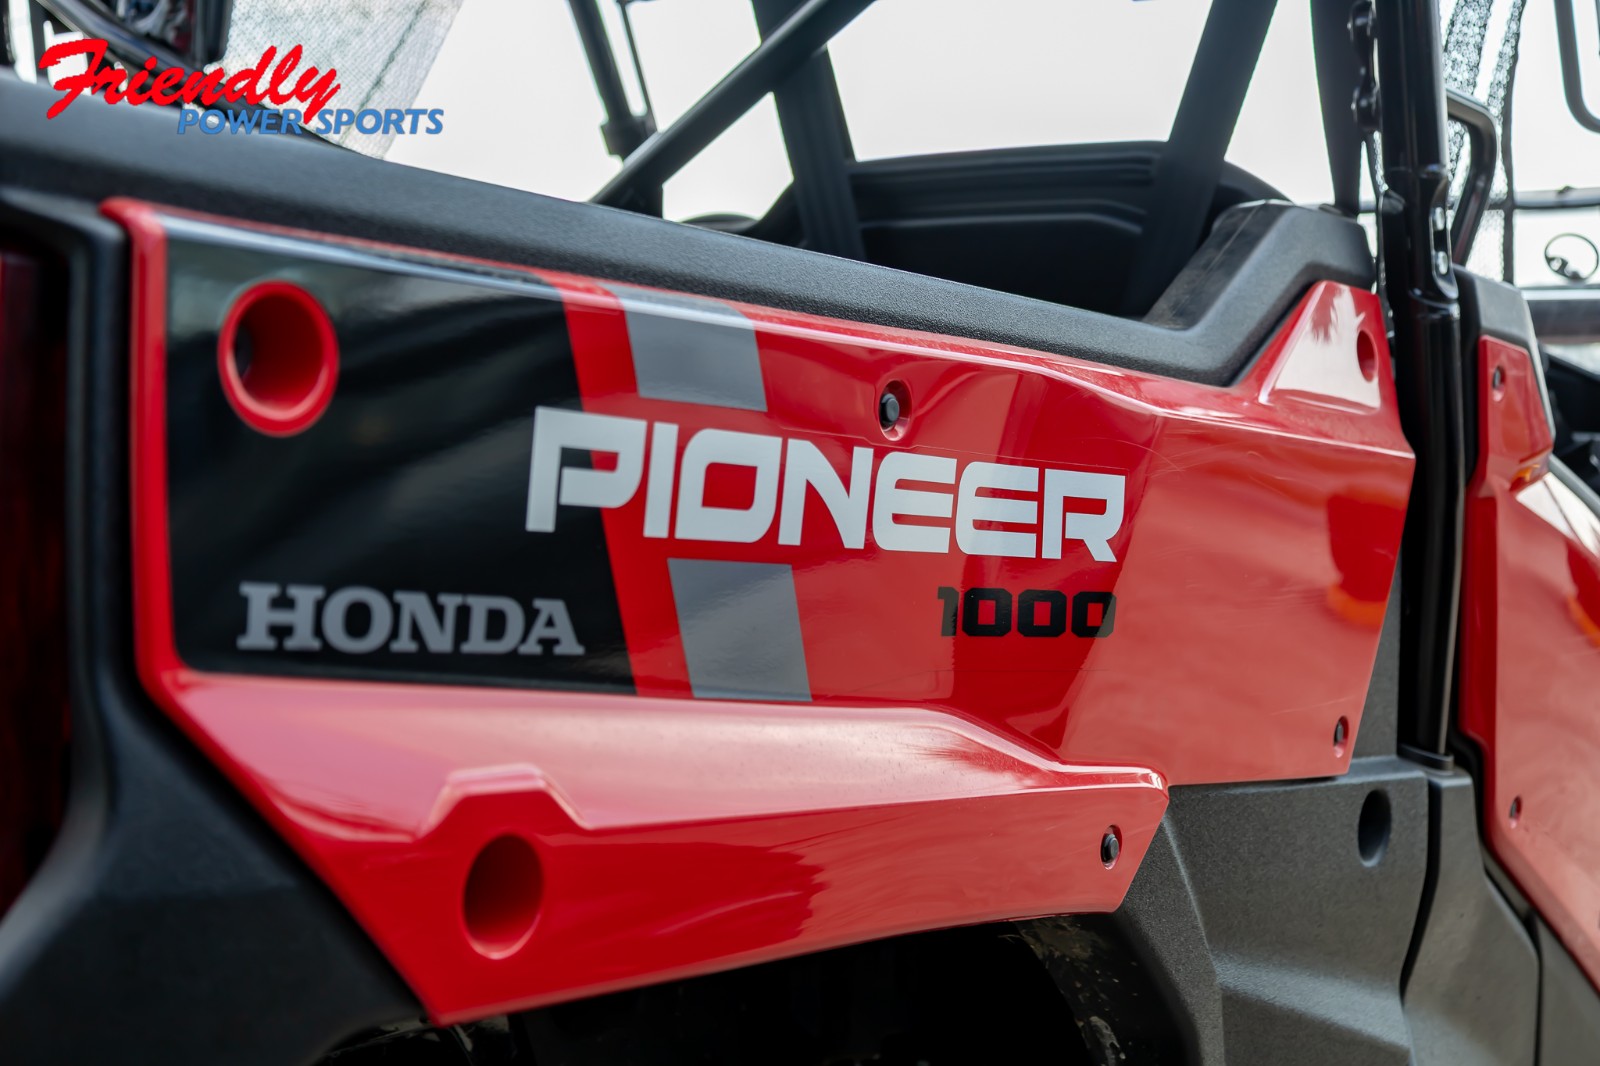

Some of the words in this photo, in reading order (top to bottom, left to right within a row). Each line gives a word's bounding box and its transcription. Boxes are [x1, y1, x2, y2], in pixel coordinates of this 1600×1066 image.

[525, 406, 1125, 562] PIONEER
[236, 581, 585, 656] HONDA
[937, 586, 1117, 638] 1000
